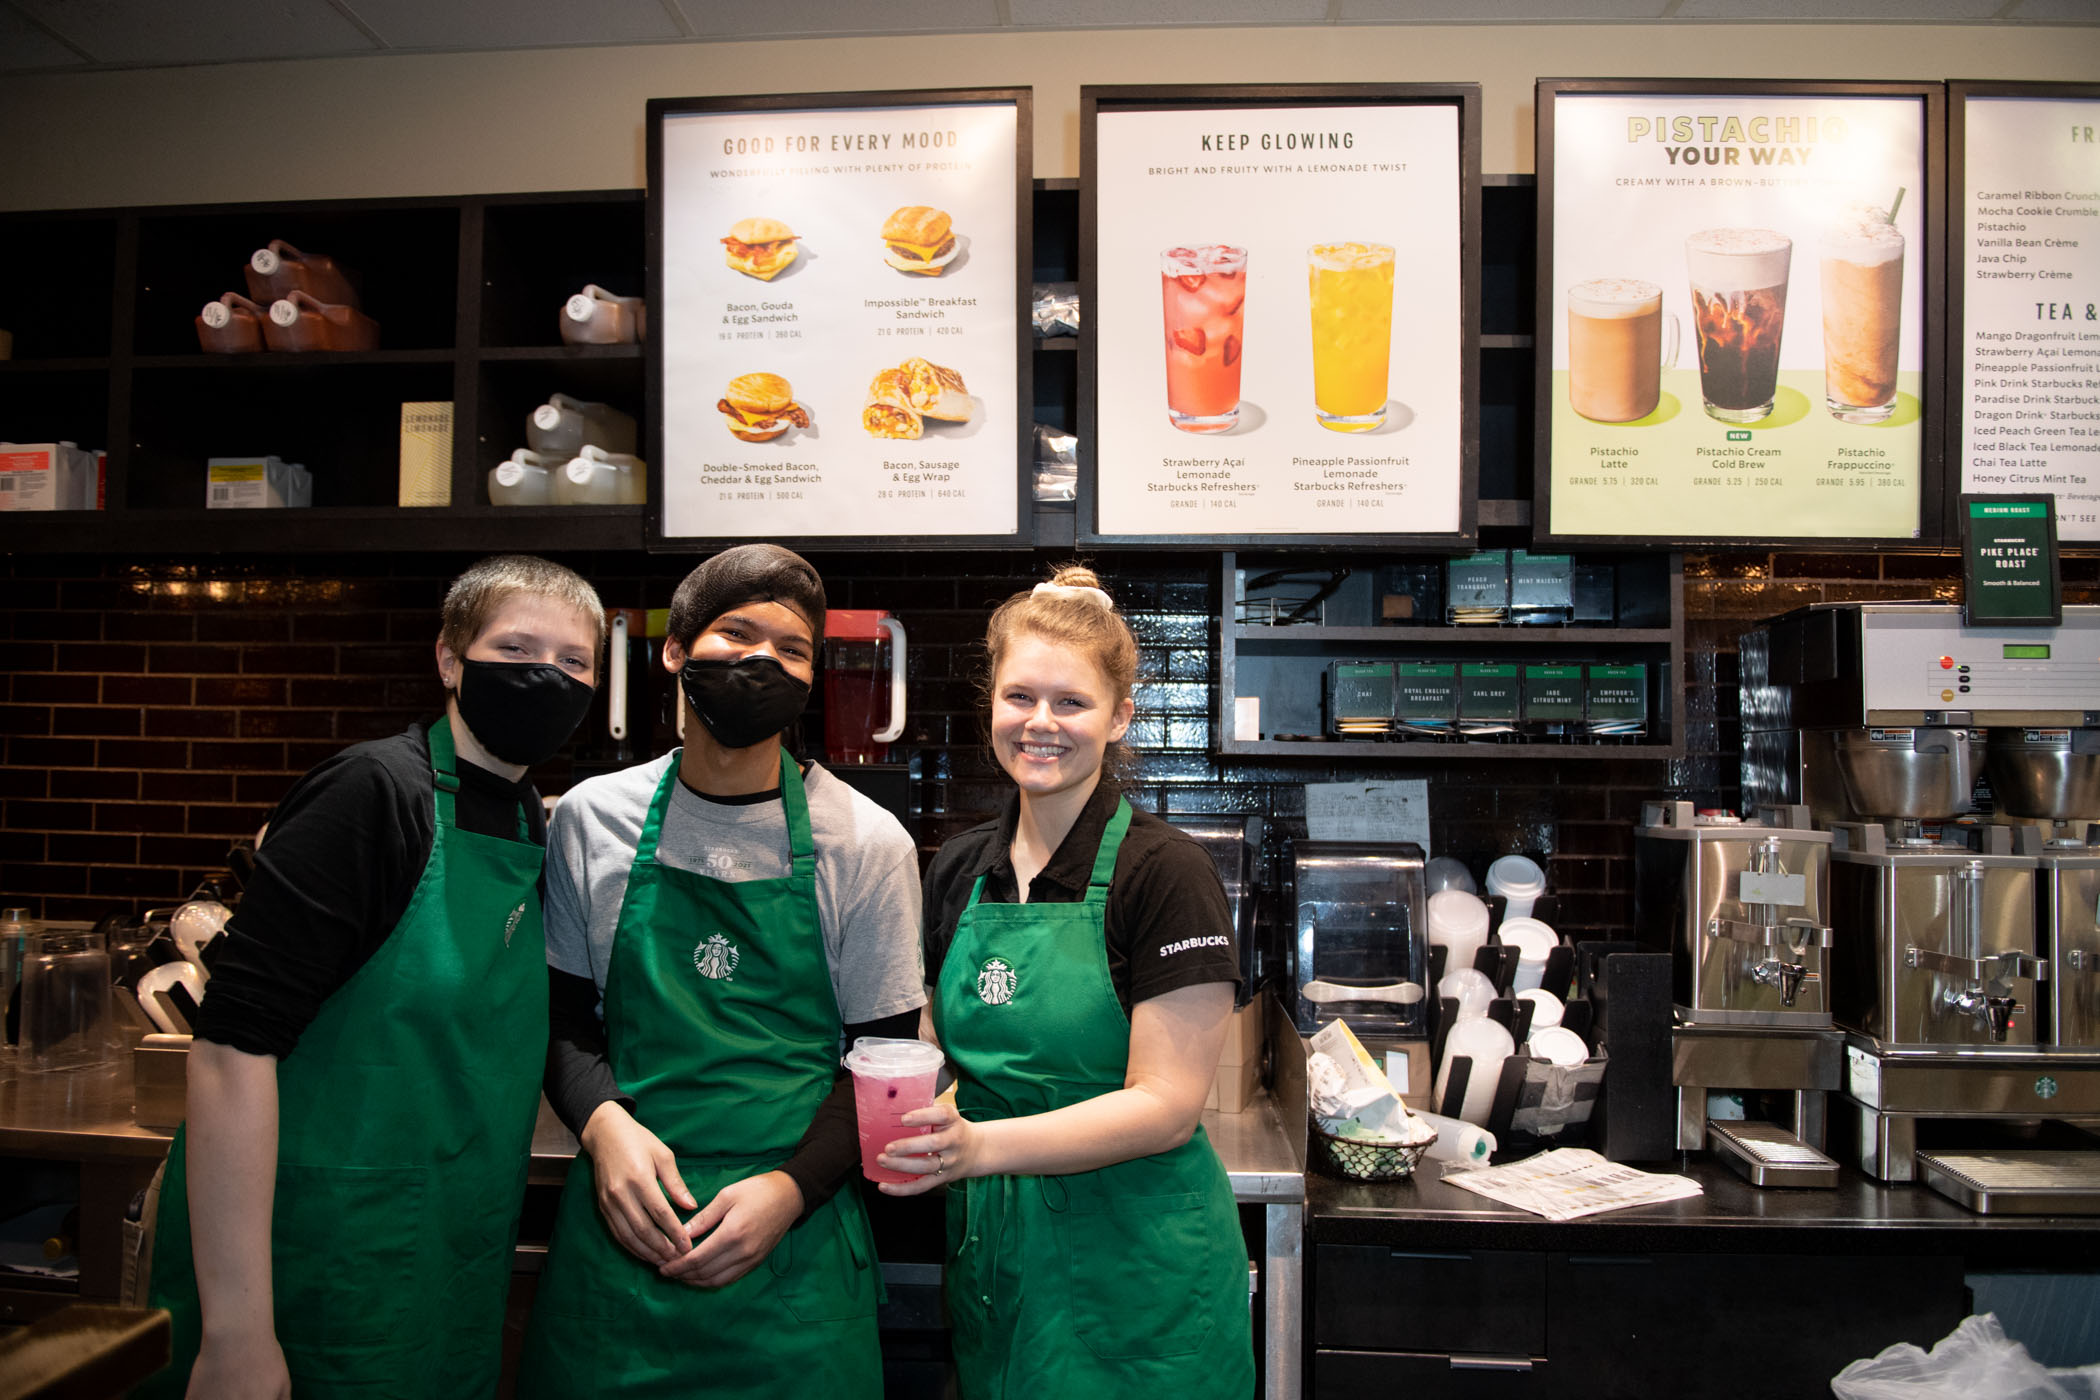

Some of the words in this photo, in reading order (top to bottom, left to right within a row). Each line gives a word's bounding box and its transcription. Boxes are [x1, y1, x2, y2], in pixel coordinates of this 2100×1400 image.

[1628, 116, 1849, 143] PISTACHIO
[724, 138, 775, 155] GOOD
[786, 136, 821, 153] FOR
[831, 134, 892, 152] EVERY
[902, 131, 958, 149] MOOD
[1202, 134, 1250, 151] KEEP
[1261, 132, 1355, 150] GLOWING
[1664, 147, 1740, 166] YOUR
[1750, 146, 1813, 166] WAY
[834, 165, 862, 174] WITH
[866, 164, 903, 173] PLENTY
[908, 164, 921, 172] OF
[1148, 166, 1190, 176] BRIGHT
[1194, 166, 1218, 175] AND
[1221, 165, 1259, 175] FRUITY
[1264, 164, 1293, 174] WITH
[1297, 164, 1304, 173] A
[1308, 163, 1369, 173] LEMONADE
[1372, 162, 1408, 172] TWIST
[1616, 178, 1661, 187] CREAMY
[1666, 178, 1696, 187] WITH
[1699, 178, 1707, 187] A
[1977, 191, 2022, 201] Caramel
[2025, 191, 2062, 201] Ribbon
[1978, 207, 2014, 216] Mocha
[2016, 207, 2053, 216] Cookie
[2055, 207, 2099, 217] Crumble
[1978, 222, 2027, 232] Pistachio
[1977, 238, 2013, 248] Vanilla
[2016, 238, 2042, 248] Bean
[2044, 238, 2079, 248] Crème
[1976, 254, 2000, 264] Java
[2002, 254, 2027, 265] Chip
[1976, 270, 2036, 281] Strawberry
[2038, 270, 2073, 280] Crème
[727, 302, 758, 313] Bacon,
[761, 301, 794, 312] Gouda
[928, 296, 978, 308] Breakfast
[896, 308, 945, 320] Sandwich
[2036, 303, 2073, 320] TEA
[2086, 304, 2098, 321] &
[722, 316, 730, 325] &
[732, 315, 750, 327] Egg
[752, 312, 799, 324] Sandwich
[736, 331, 764, 340] PROTEIN
[896, 327, 925, 336] PROTEIN
[936, 326, 950, 336] 420
[952, 326, 963, 335] CAL
[1976, 332, 2013, 344] Mango
[2016, 331, 2076, 343] Dragonfruit
[1976, 347, 2034, 359] Strawberry
[1976, 363, 2028, 375] Pineapple
[2031, 362, 2094, 373] Passionfruit
[1974, 378, 1998, 389] Pink
[2000, 378, 2028, 389] Drink
[2032, 378, 2084, 389] Starbucks
[1974, 394, 2021, 405] Paradise
[2023, 394, 2051, 405] Drink
[1974, 410, 2013, 422] Dragon
[2050, 411, 2100, 421] Starbucks
[1730, 432, 1748, 440] NEW
[1974, 426, 1997, 436] Iced
[1999, 426, 2031, 436] Peach
[2034, 426, 2067, 437] Green
[2069, 426, 2086, 437] Tea
[1590, 447, 1639, 457] Pistachio
[1696, 447, 1746, 457] Pistachio
[1748, 448, 1782, 457] Cream
[1973, 442, 1996, 452] Iced
[1998, 442, 2028, 452] Black
[2030, 442, 2047, 452] Tea
[1838, 448, 1886, 458] Pistachio
[703, 462, 783, 473] Double-Smoked
[786, 462, 819, 473] Bacon,
[883, 462, 917, 472] Bacon,
[919, 460, 960, 473] Sausage
[1162, 457, 1220, 469] Strawberry
[1292, 457, 1345, 468] Pineapple
[1348, 456, 1410, 466] Passionfruit
[1600, 459, 1628, 469] Latte
[1712, 459, 1736, 470] Cold
[1738, 459, 1766, 470] Brew
[1972, 458, 1997, 468] Chai
[2000, 458, 2018, 468] Tea
[2020, 458, 2047, 468] Latte
[893, 472, 900, 483] &
[903, 472, 921, 485] Egg
[922, 472, 951, 484] Wrap
[1177, 470, 1231, 480] Lemonade
[1323, 468, 1379, 479] Lemonade
[700, 474, 743, 485] Cheddar
[745, 474, 753, 485] &
[754, 474, 772, 487] Egg
[774, 472, 822, 484] Sandwich
[1570, 477, 1598, 486] GRANDE
[1603, 477, 1618, 486] 5.75
[1630, 477, 1644, 486] 320
[1646, 477, 1659, 486] CAL
[1693, 478, 1721, 486] GRANDE
[1726, 478, 1743, 486] 5.25
[1754, 478, 1769, 486] 250
[1770, 478, 1783, 486] CAL
[1816, 478, 1844, 487] GRANDE
[1848, 478, 1865, 487] 5.95
[1893, 478, 1905, 487] CAL
[1972, 474, 2007, 486] Honey
[2009, 474, 2040, 484] Citrus
[2044, 474, 2068, 484] Mint
[2070, 474, 2087, 484] Tea
[1148, 482, 1199, 492] Starbucks
[1294, 482, 1346, 492] Starbucks
[738, 492, 765, 501] PROTEIN
[898, 489, 926, 499] PROTEIN
[952, 488, 966, 498] CAL
[1170, 500, 1198, 509] GRANDE
[1210, 500, 1223, 509] 140
[1224, 500, 1237, 509] CAL
[1316, 499, 1345, 508] GRANDE
[1357, 499, 1370, 508] 140
[1371, 499, 1384, 508] CAL
[2080, 515, 2097, 523] SEE
[1980, 548, 2004, 557] PIKE
[1996, 560, 2026, 568] ROAST
[704, 846, 738, 854] STARBUCKS
[706, 854, 733, 869] 50
[699, 868, 737, 879] YEARS
[1160, 936, 1230, 957] STARBUCKS
